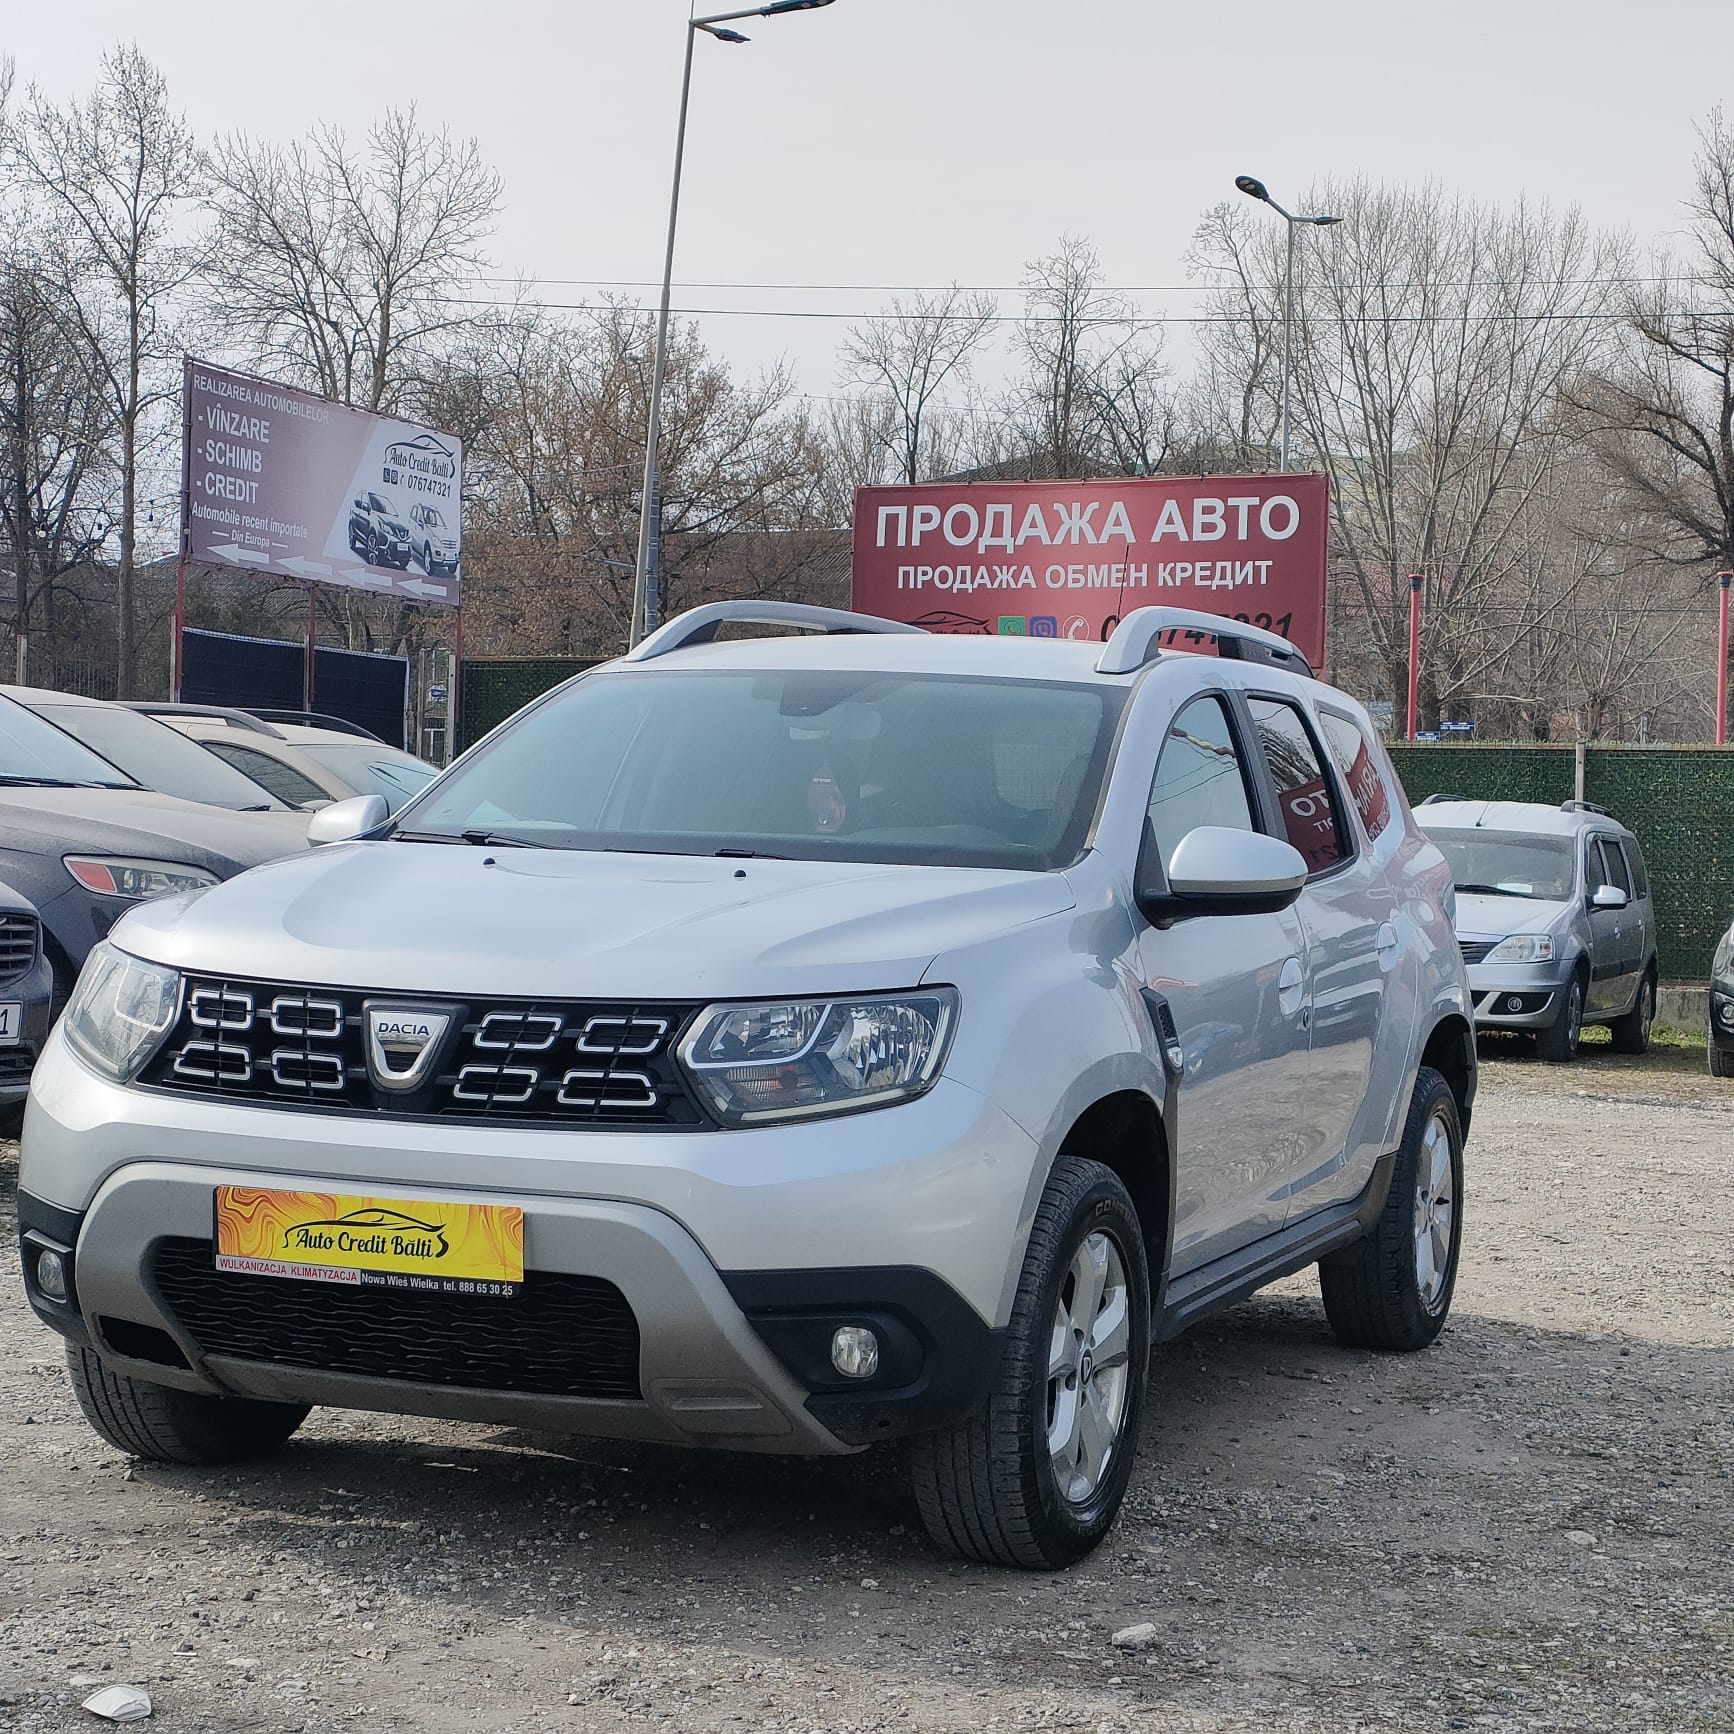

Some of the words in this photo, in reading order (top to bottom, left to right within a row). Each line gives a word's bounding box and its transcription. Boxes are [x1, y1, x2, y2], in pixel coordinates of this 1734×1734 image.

[194, 374, 252, 403] REALIZAREA
[253, 391, 329, 424] AUTOMOBILELOR
[206, 403, 270, 443] VÎNZARE
[206, 439, 262, 473] SCHIMB
[390, 447, 407, 467] Auto
[408, 452, 430, 473] Credit
[205, 472, 259, 504] CREDIT
[407, 474, 451, 498] 076747321
[191, 501, 240, 525] Automobile
[241, 515, 269, 531] recent
[270, 518, 308, 538] importate
[876, 501, 1135, 554] ПРОДАЖА
[1151, 495, 1300, 543] АВТО
[231, 530, 244, 542] Din
[245, 532, 270, 548] Europa
[897, 565, 1035, 593] ПРОДАЖА
[1045, 563, 1148, 588] ОБМЕН
[1158, 560, 1273, 590] КРЕДИТ
[378, 1022, 430, 1036] DACIA
[296, 1228, 335, 1249] Auto
[337, 1231, 388, 1254] Credit
[220, 1258, 287, 1275] WULKANIZACJA
[291, 1266, 357, 1282] KLIMATYZACJA
[361, 1273, 385, 1285] Nowa
[387, 1275, 408, 1287] Wieś
[410, 1277, 439, 1290] Wielka
[443, 1280, 457, 1291] tel.
[458, 1281, 475, 1293] 888
[476, 1283, 487, 1294] 65
[489, 1284, 500, 1295] 30
